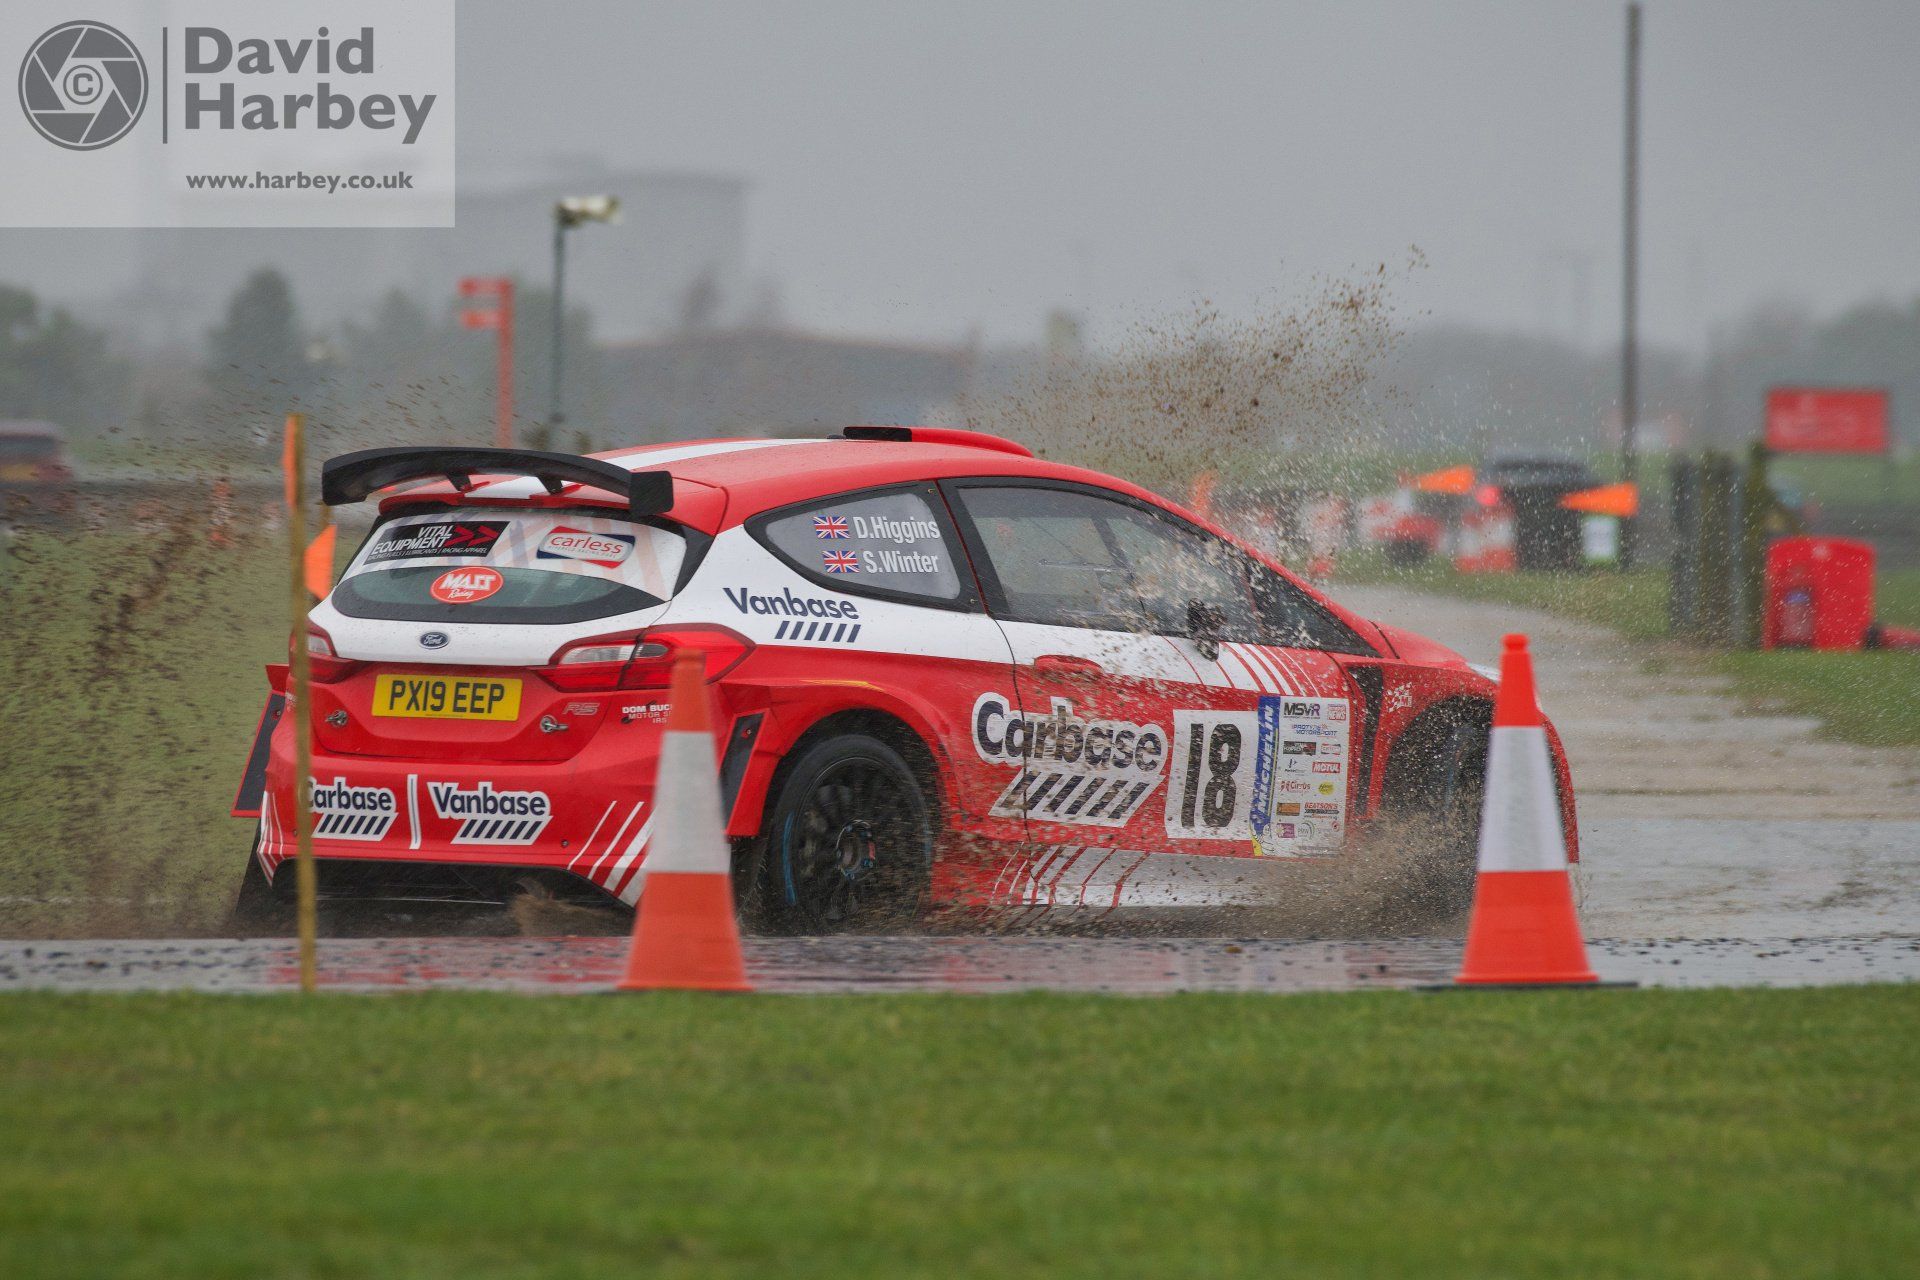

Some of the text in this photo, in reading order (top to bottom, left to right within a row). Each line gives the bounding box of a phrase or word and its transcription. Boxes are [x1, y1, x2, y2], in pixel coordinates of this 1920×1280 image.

[418, 525, 454, 538] VITAL
[853, 516, 941, 544] D.Higgins
[371, 536, 450, 556] EQUIPMENT
[551, 536, 623, 554] carless
[863, 551, 938, 574] S.Winter
[722, 587, 859, 620] Vanbase
[424, 634, 443, 645] Ford
[389, 680, 505, 714] PX19 EEP
[563, 702, 599, 715] RS
[622, 705, 646, 714] DOM
[628, 712, 659, 720] MOTOR
[977, 700, 1162, 772] Carbase
[1257, 705, 1275, 814] MICHELIN
[1313, 763, 1339, 773] MOTUL
[1181, 723, 1242, 828] 18
[434, 786, 546, 816] Vanbase
